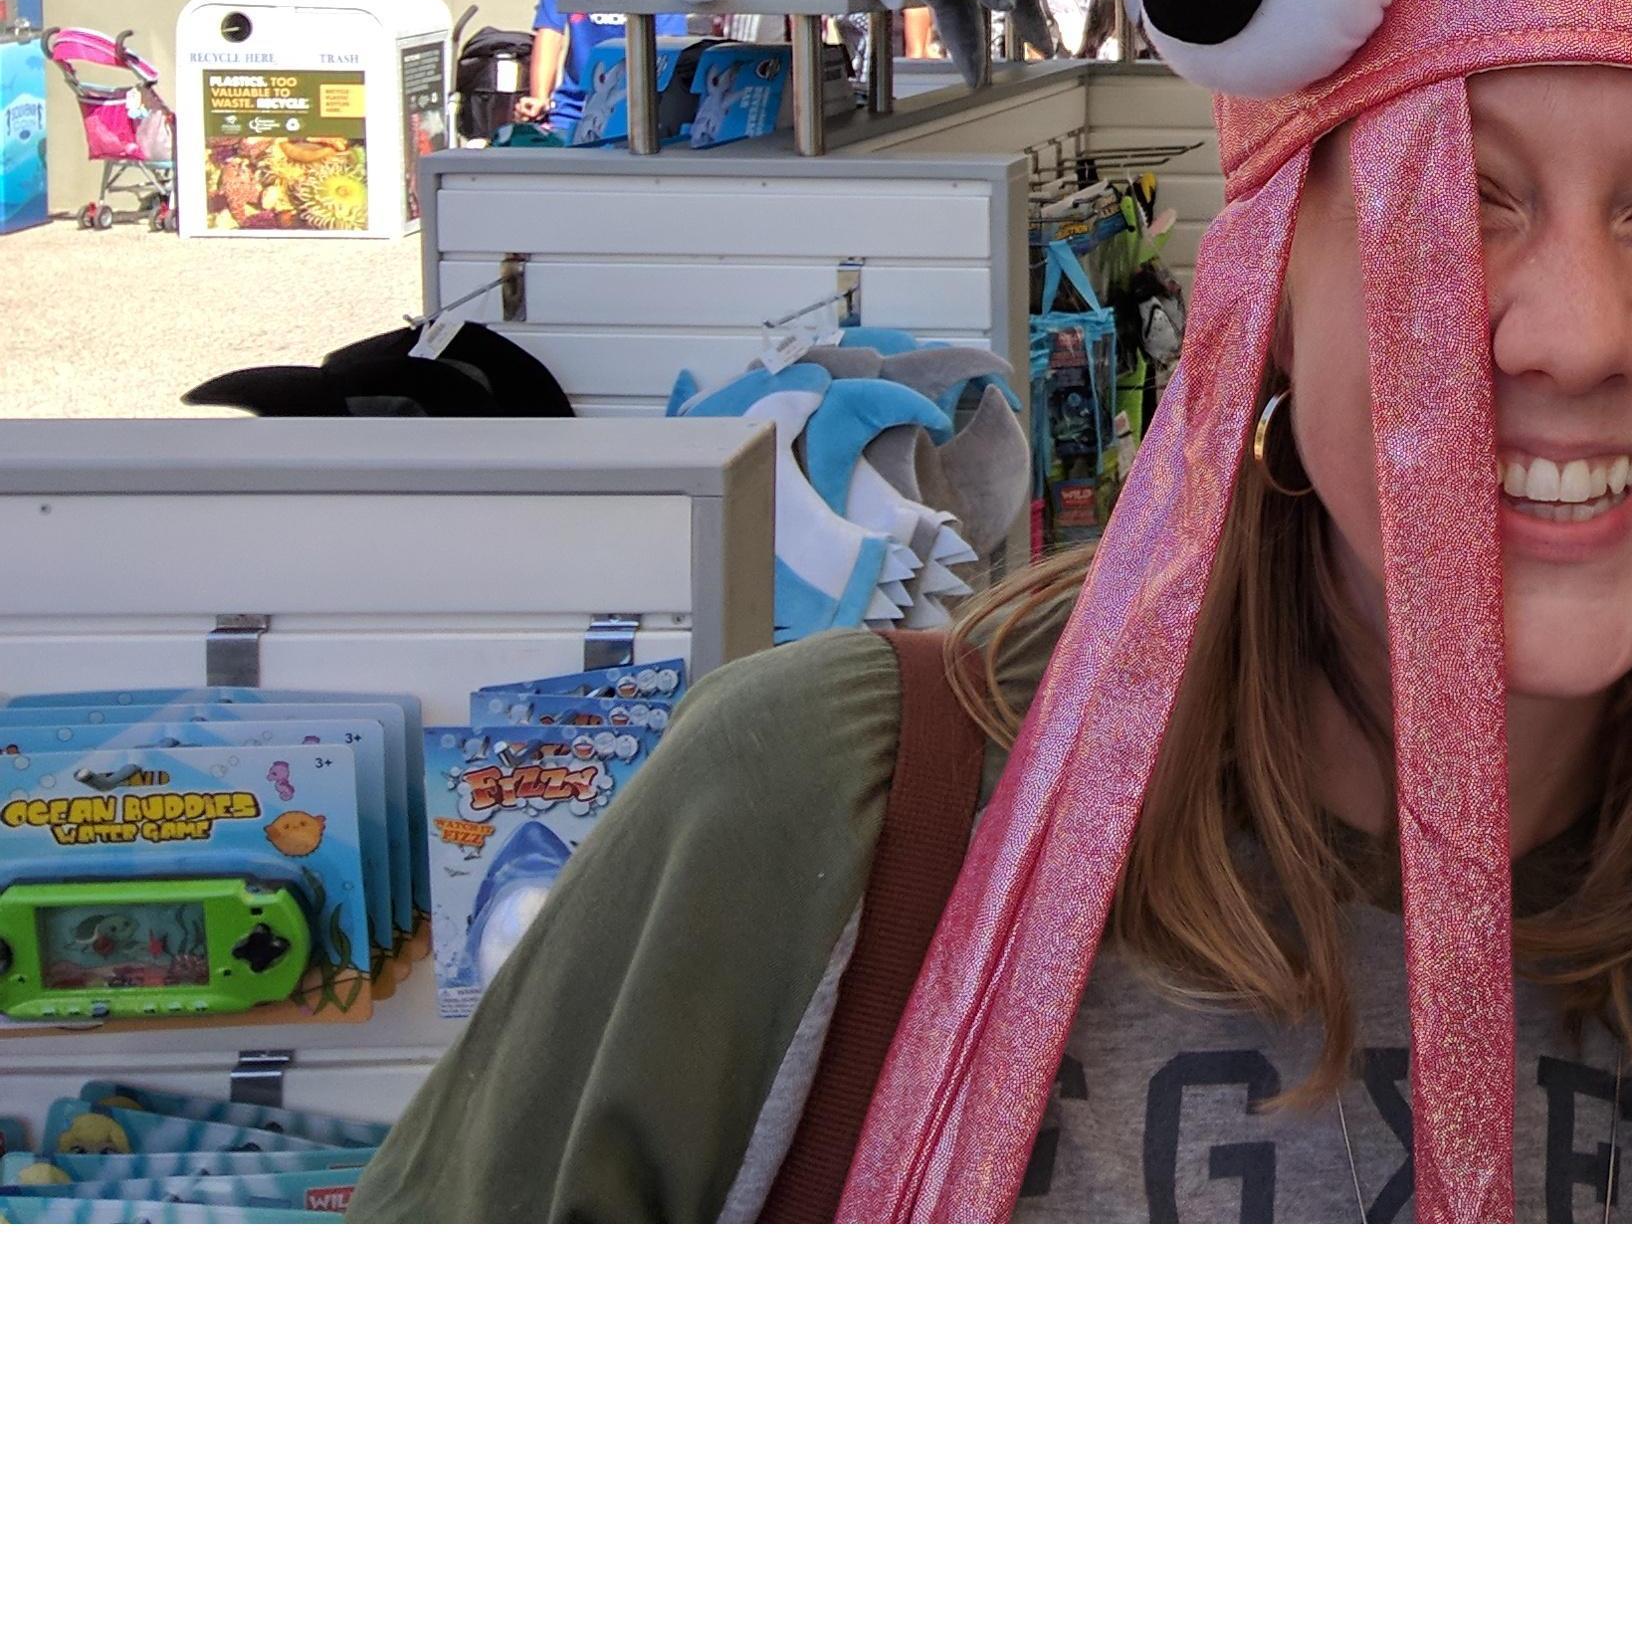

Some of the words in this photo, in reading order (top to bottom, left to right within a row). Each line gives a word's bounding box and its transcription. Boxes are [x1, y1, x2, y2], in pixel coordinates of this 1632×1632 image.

[189, 52, 240, 64] RECYCLE
[245, 53, 275, 64] HERE
[319, 53, 359, 65] TRASH
[270, 77, 297, 88] TOO
[211, 87, 271, 98] VALUABLE
[274, 88, 291, 98] TO
[211, 98, 254, 109] WASTE.
[345, 732, 362, 744] 3+
[315, 757, 333, 769] 3+
[463, 765, 599, 811] FIZZY
[1, 795, 117, 827] OCEAN
[122, 791, 262, 822] BUDDIES
[52, 822, 139, 845] WATER
[141, 820, 213, 843] GAME
[308, 1193, 349, 1210] WIL
